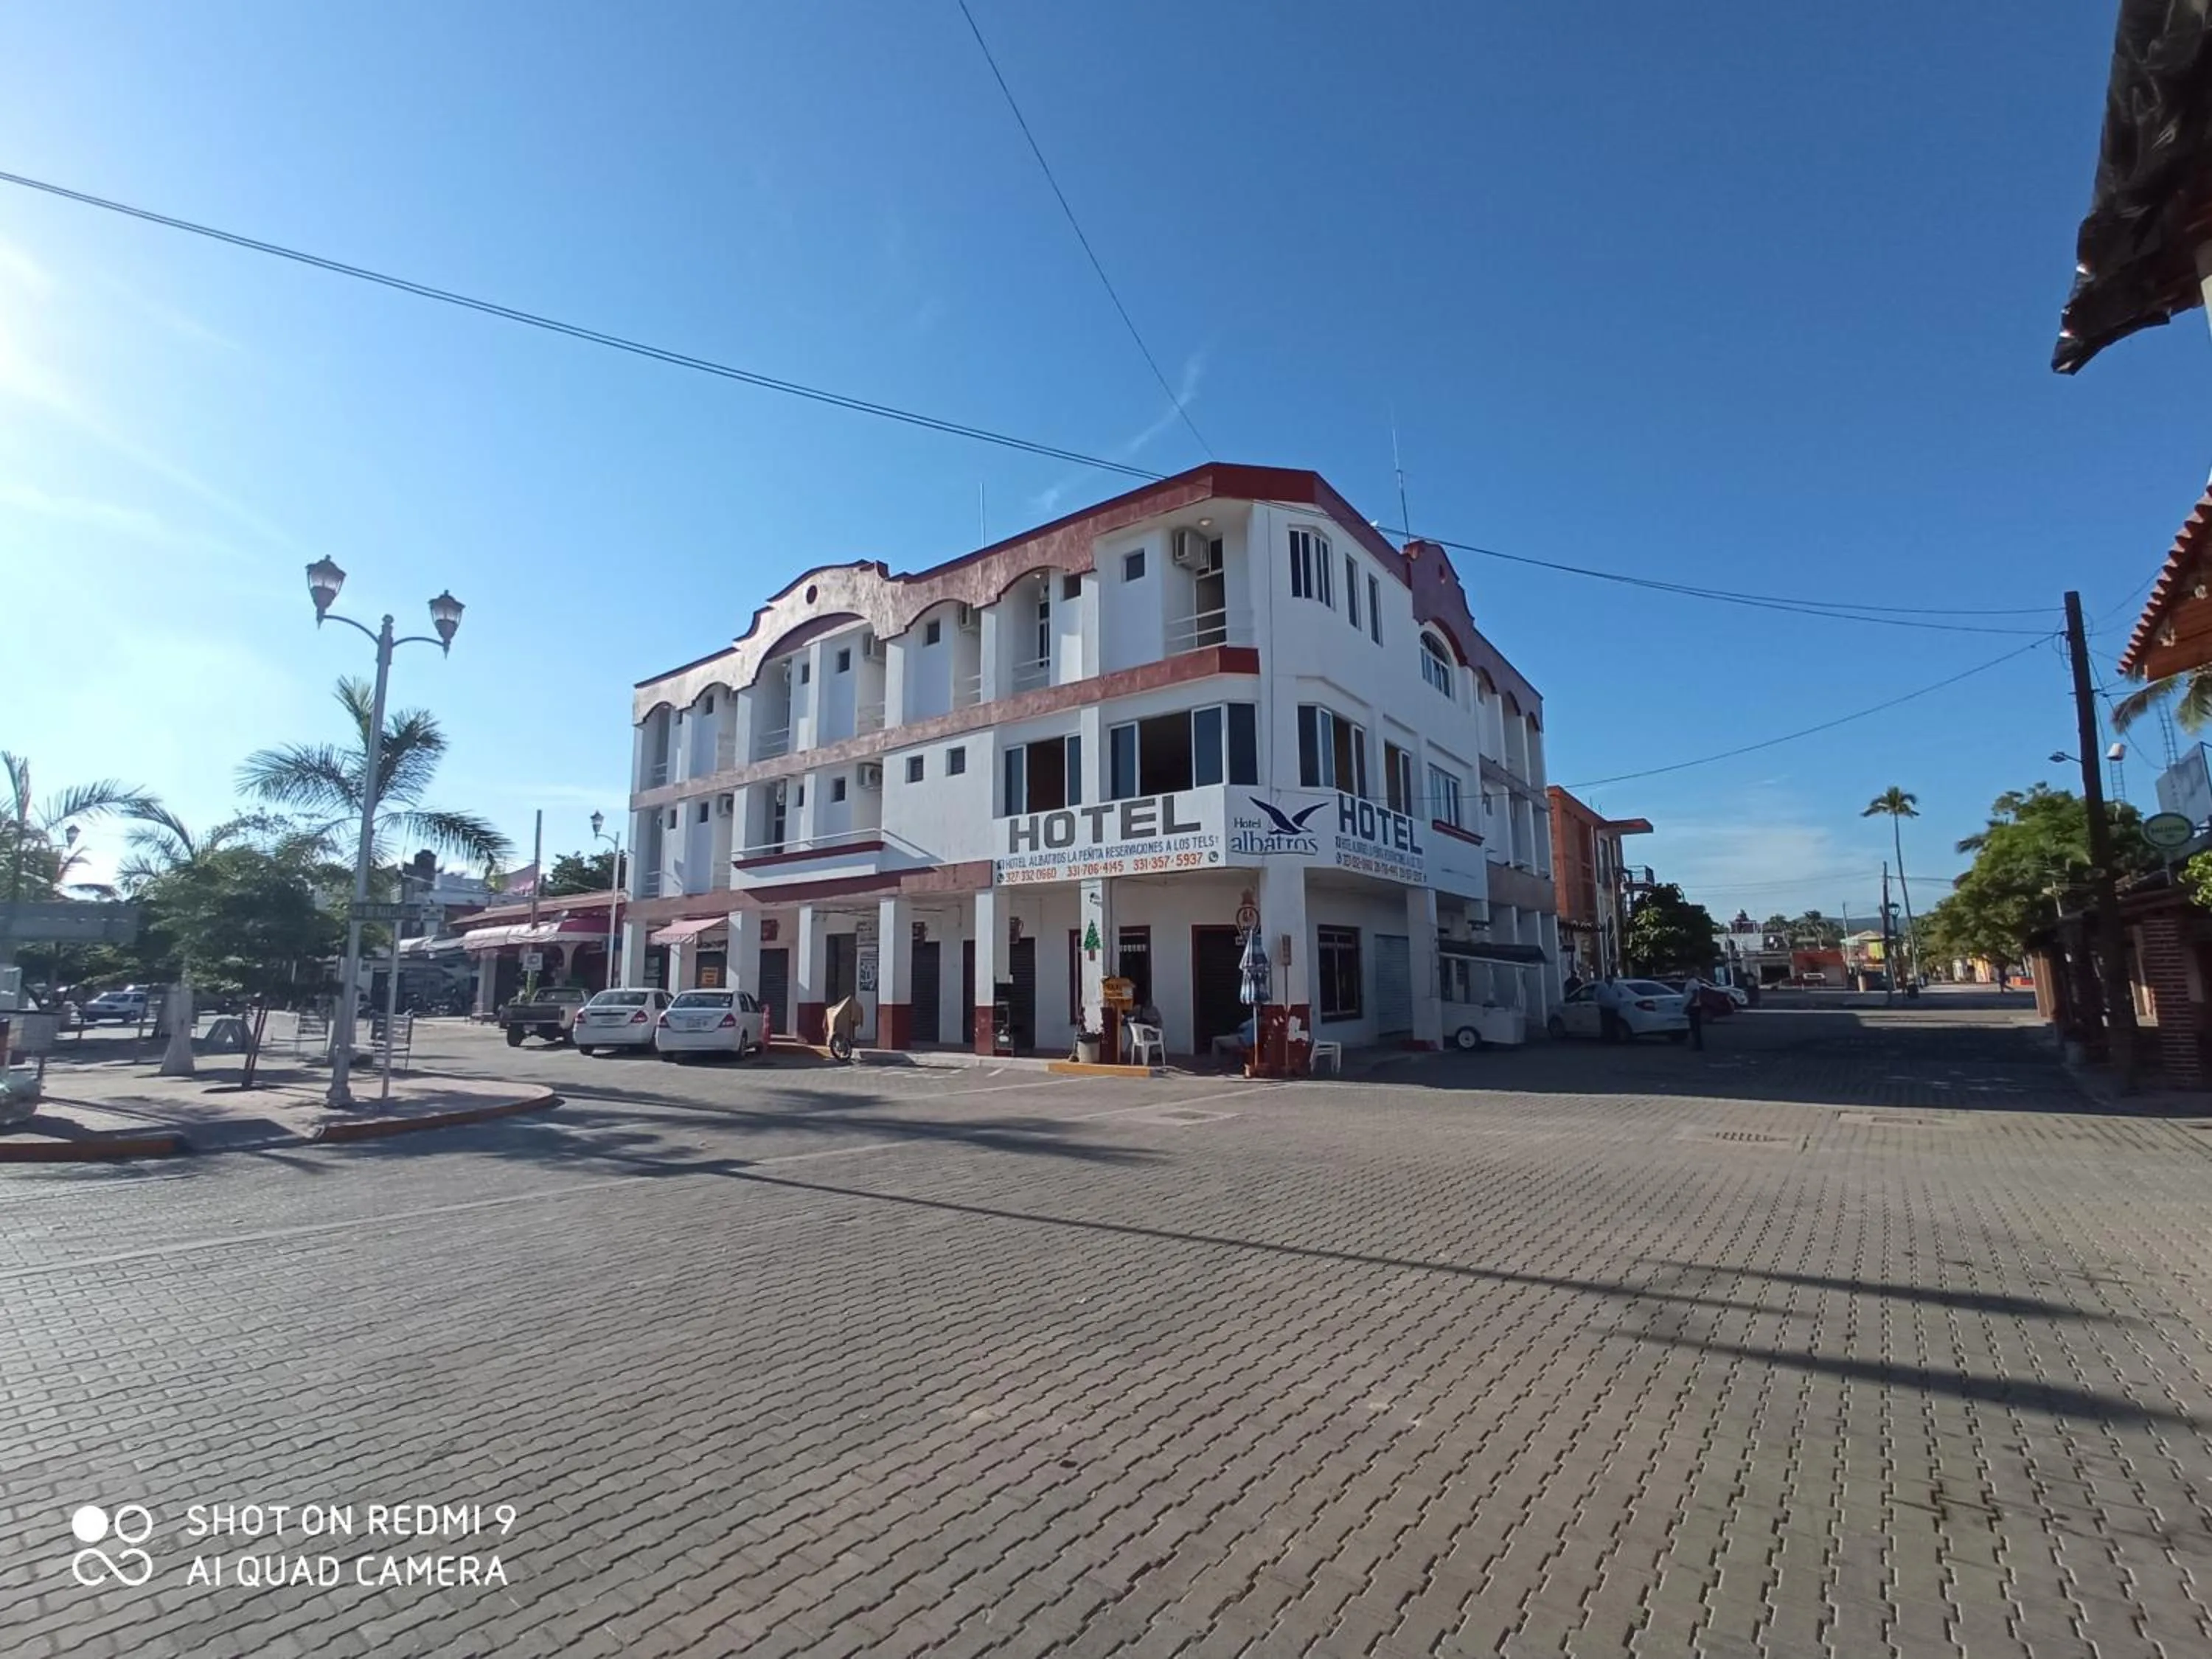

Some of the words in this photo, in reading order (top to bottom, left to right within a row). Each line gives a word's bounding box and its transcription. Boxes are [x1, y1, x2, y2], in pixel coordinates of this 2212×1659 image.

[1009, 795, 1200, 853] HOTEL
[1234, 817, 1261, 828] Hotel
[1338, 792, 1423, 855] HOTEL
[1068, 850, 1077, 863] LA
[1106, 841, 1164, 858] RESERVACIONES
[1166, 838, 1172, 851] A
[1174, 837, 1190, 851] LOS
